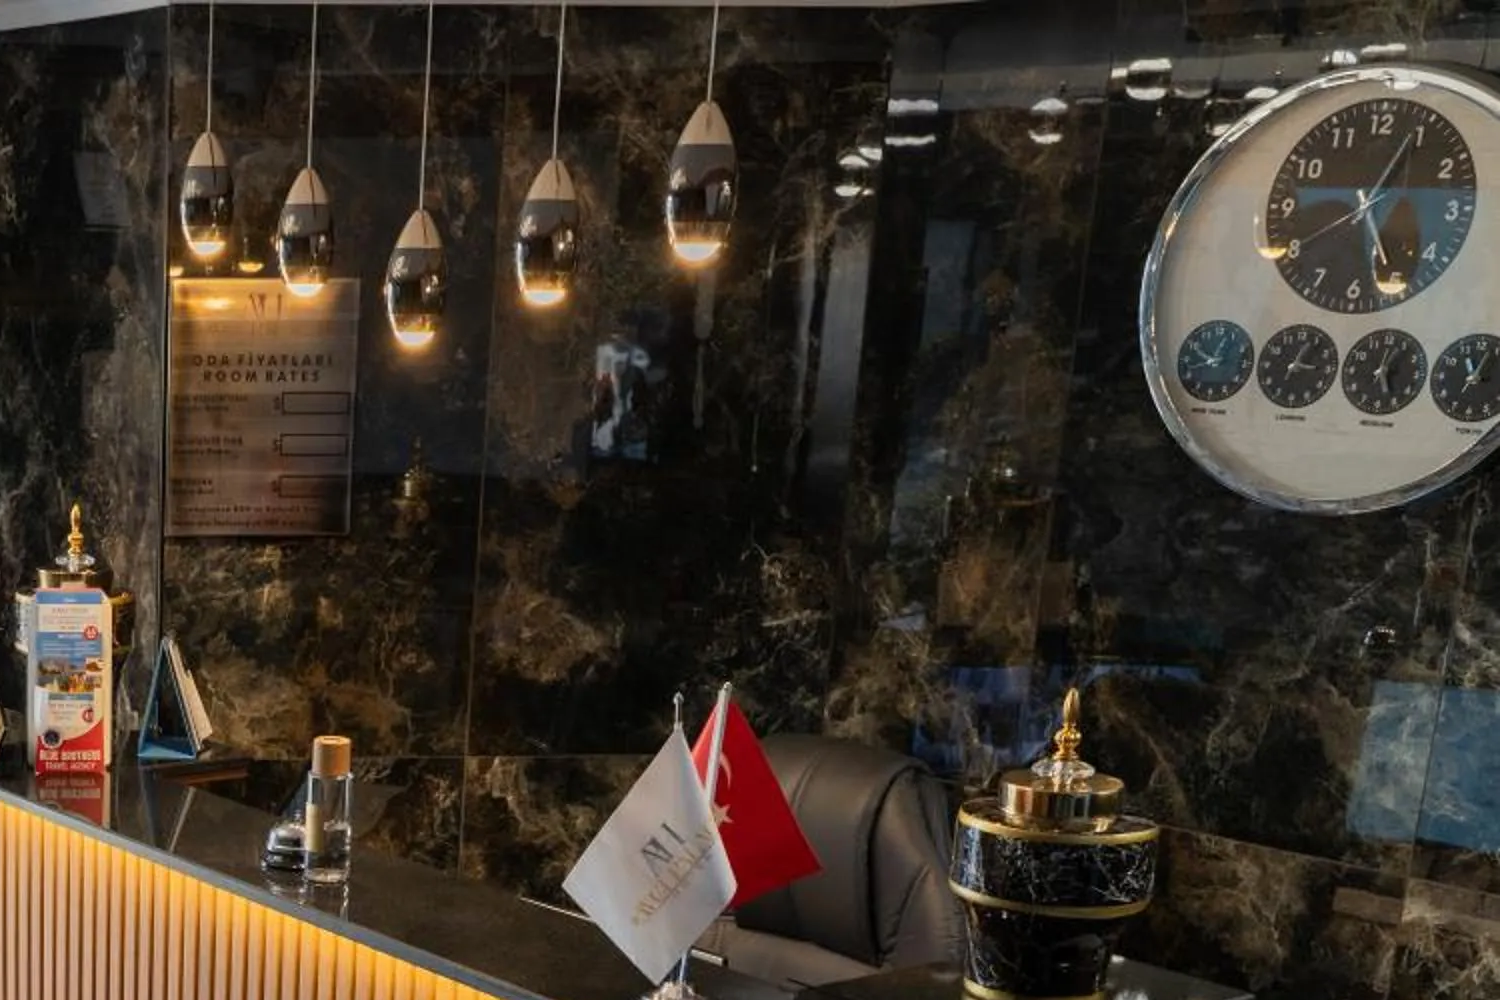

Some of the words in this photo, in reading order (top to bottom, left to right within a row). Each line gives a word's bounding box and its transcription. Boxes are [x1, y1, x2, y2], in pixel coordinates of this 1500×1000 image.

[1370, 114, 1394, 135] 12
[1331, 127, 1355, 149] 11
[1415, 126, 1425, 147] 1
[1296, 158, 1323, 179] 10
[1437, 159, 1454, 179] 2
[1281, 198, 1295, 218] 9
[1445, 200, 1459, 221] 3
[1287, 240, 1300, 258] 8
[1421, 242, 1437, 262] 4
[1314, 268, 1327, 288] 7
[1346, 278, 1361, 298] 6
[203, 370, 257, 382] ROOM
[266, 370, 320, 382] RATES
